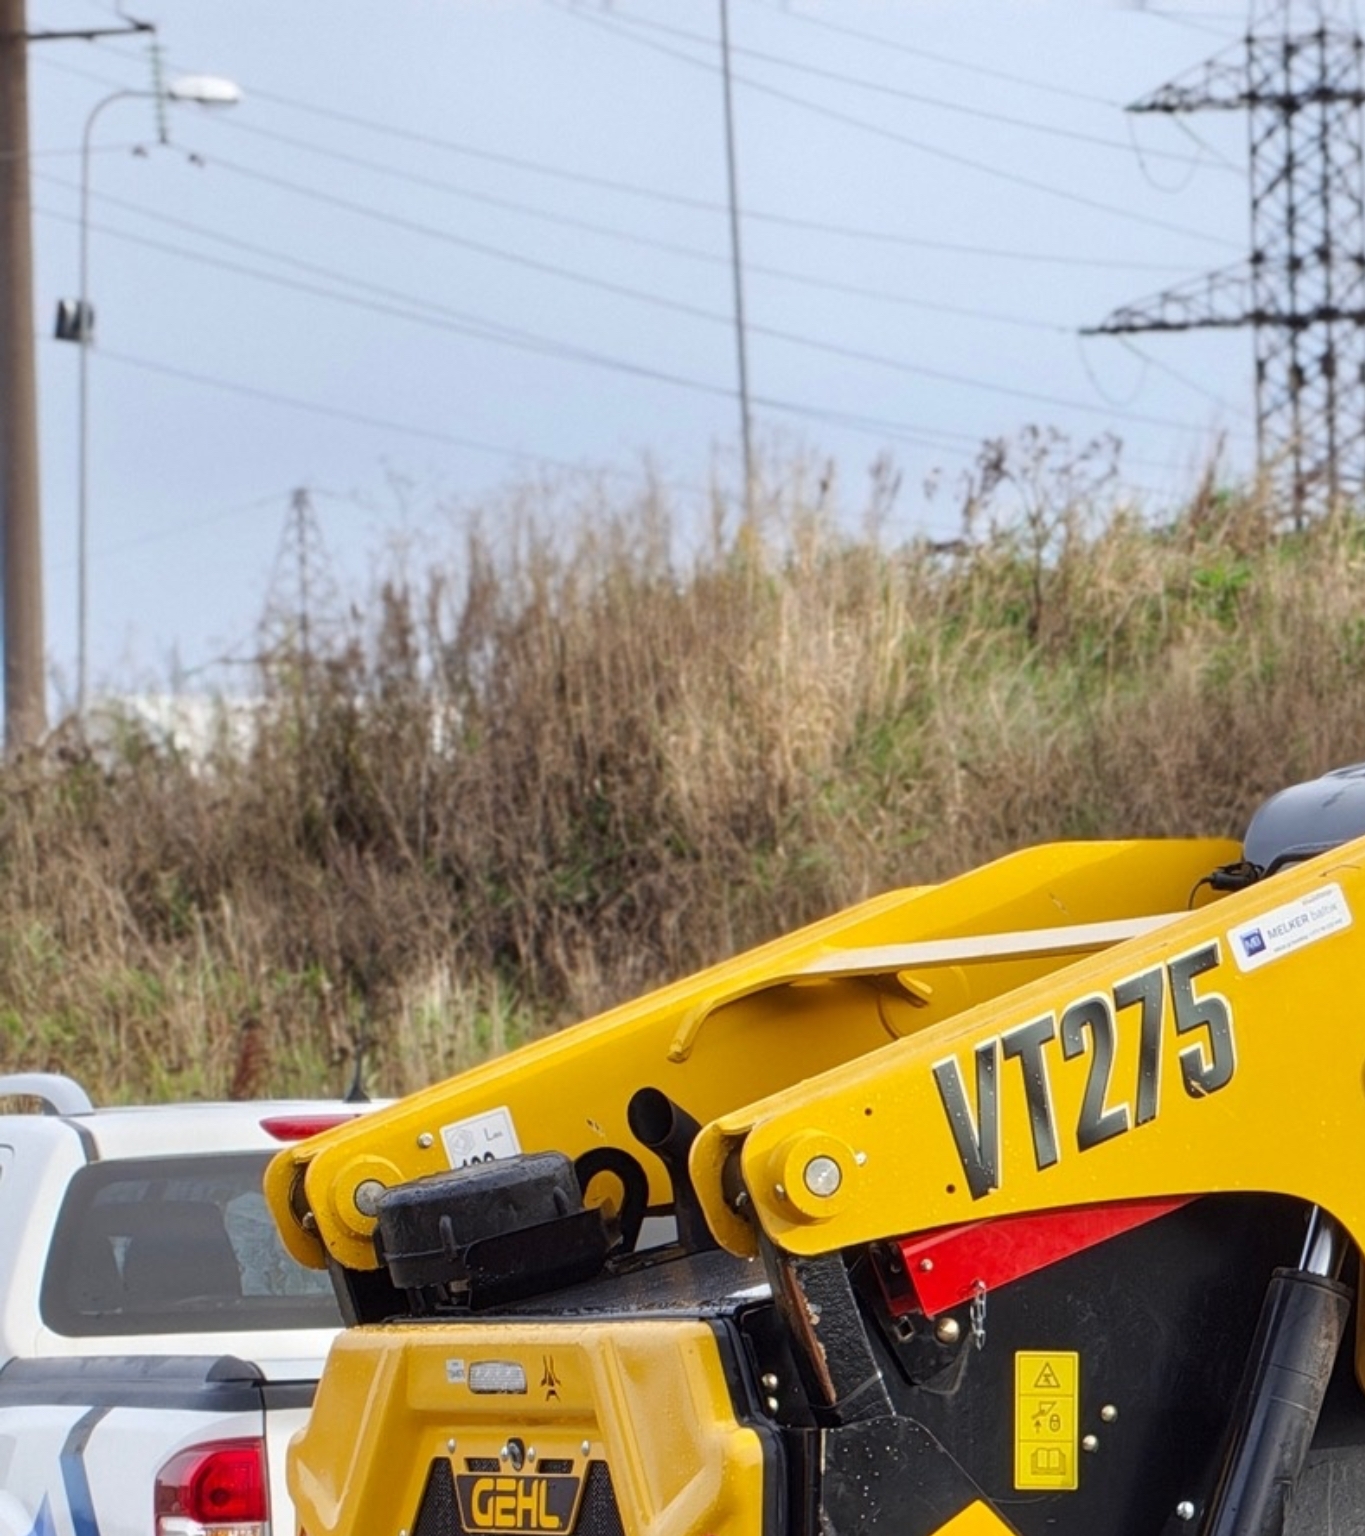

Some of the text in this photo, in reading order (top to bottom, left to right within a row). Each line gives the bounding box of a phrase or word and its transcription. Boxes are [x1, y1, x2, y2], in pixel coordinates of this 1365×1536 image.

[1267, 914, 1310, 940] MELKER
[932, 937, 1238, 1201] VT275
[471, 1477, 561, 1529] GEHL
